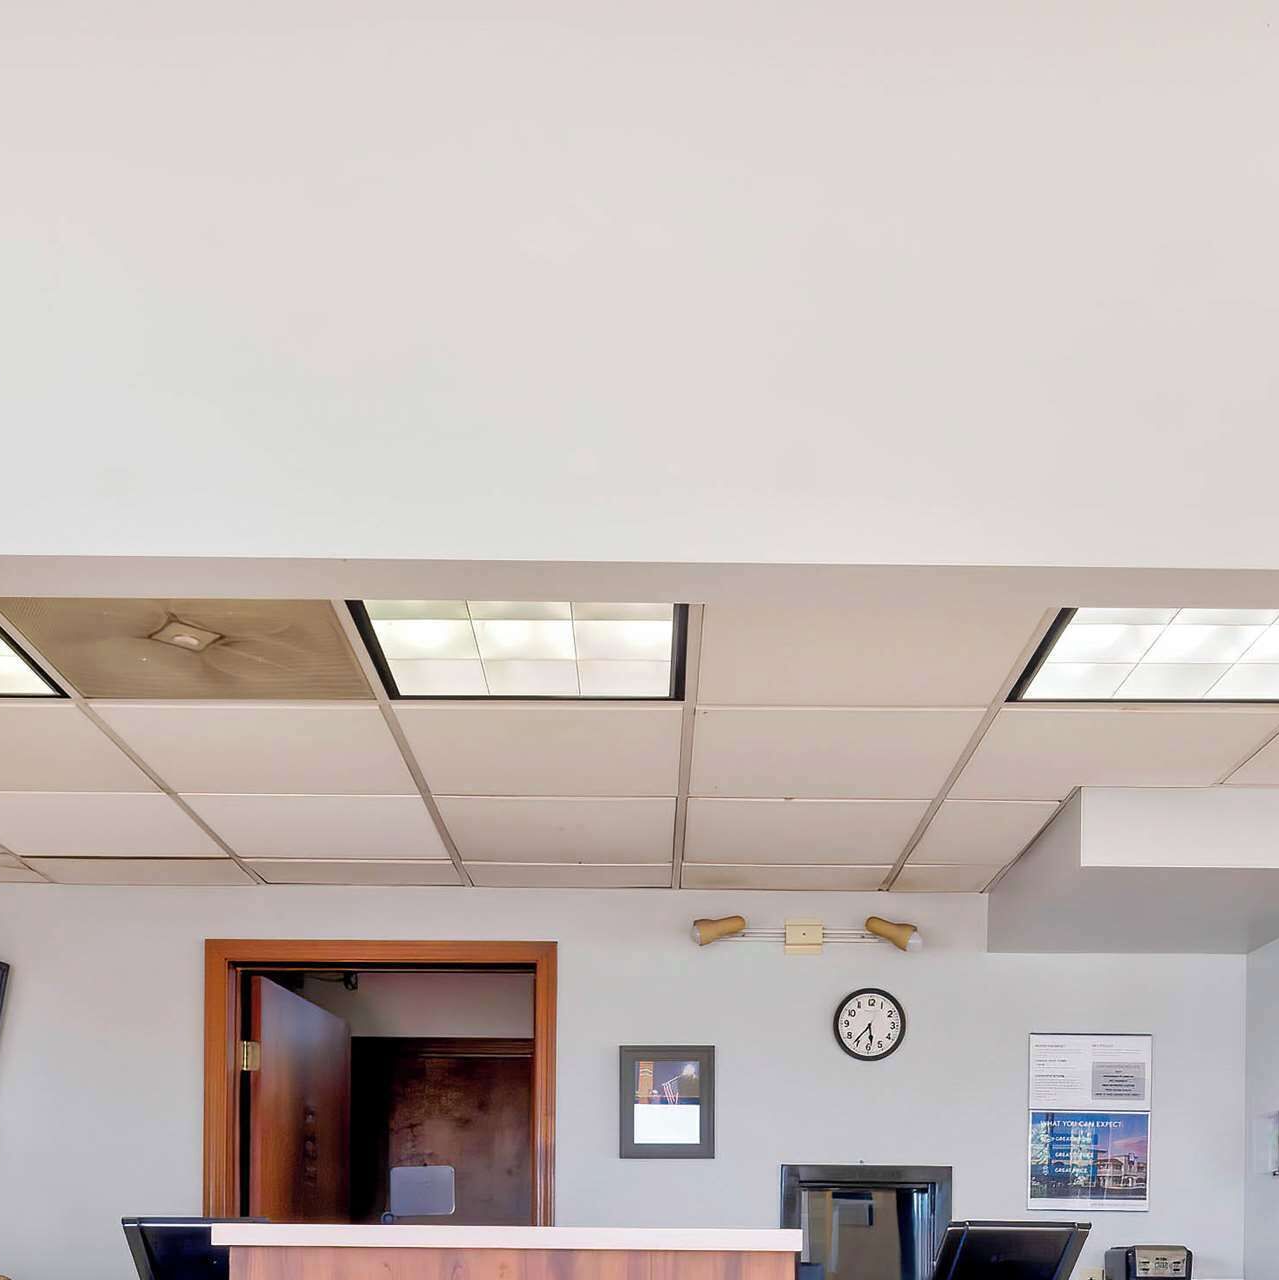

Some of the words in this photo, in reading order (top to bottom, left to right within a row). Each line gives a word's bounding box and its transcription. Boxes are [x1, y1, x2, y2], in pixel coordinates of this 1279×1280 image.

[848, 1009, 856, 1017] 10
[887, 1010, 893, 1018] 2
[844, 1019, 850, 1027] 9
[890, 1021, 896, 1030] 3
[846, 1031, 852, 1039] 8
[865, 1043, 871, 1051] 6
[877, 1040, 883, 1048] 5
